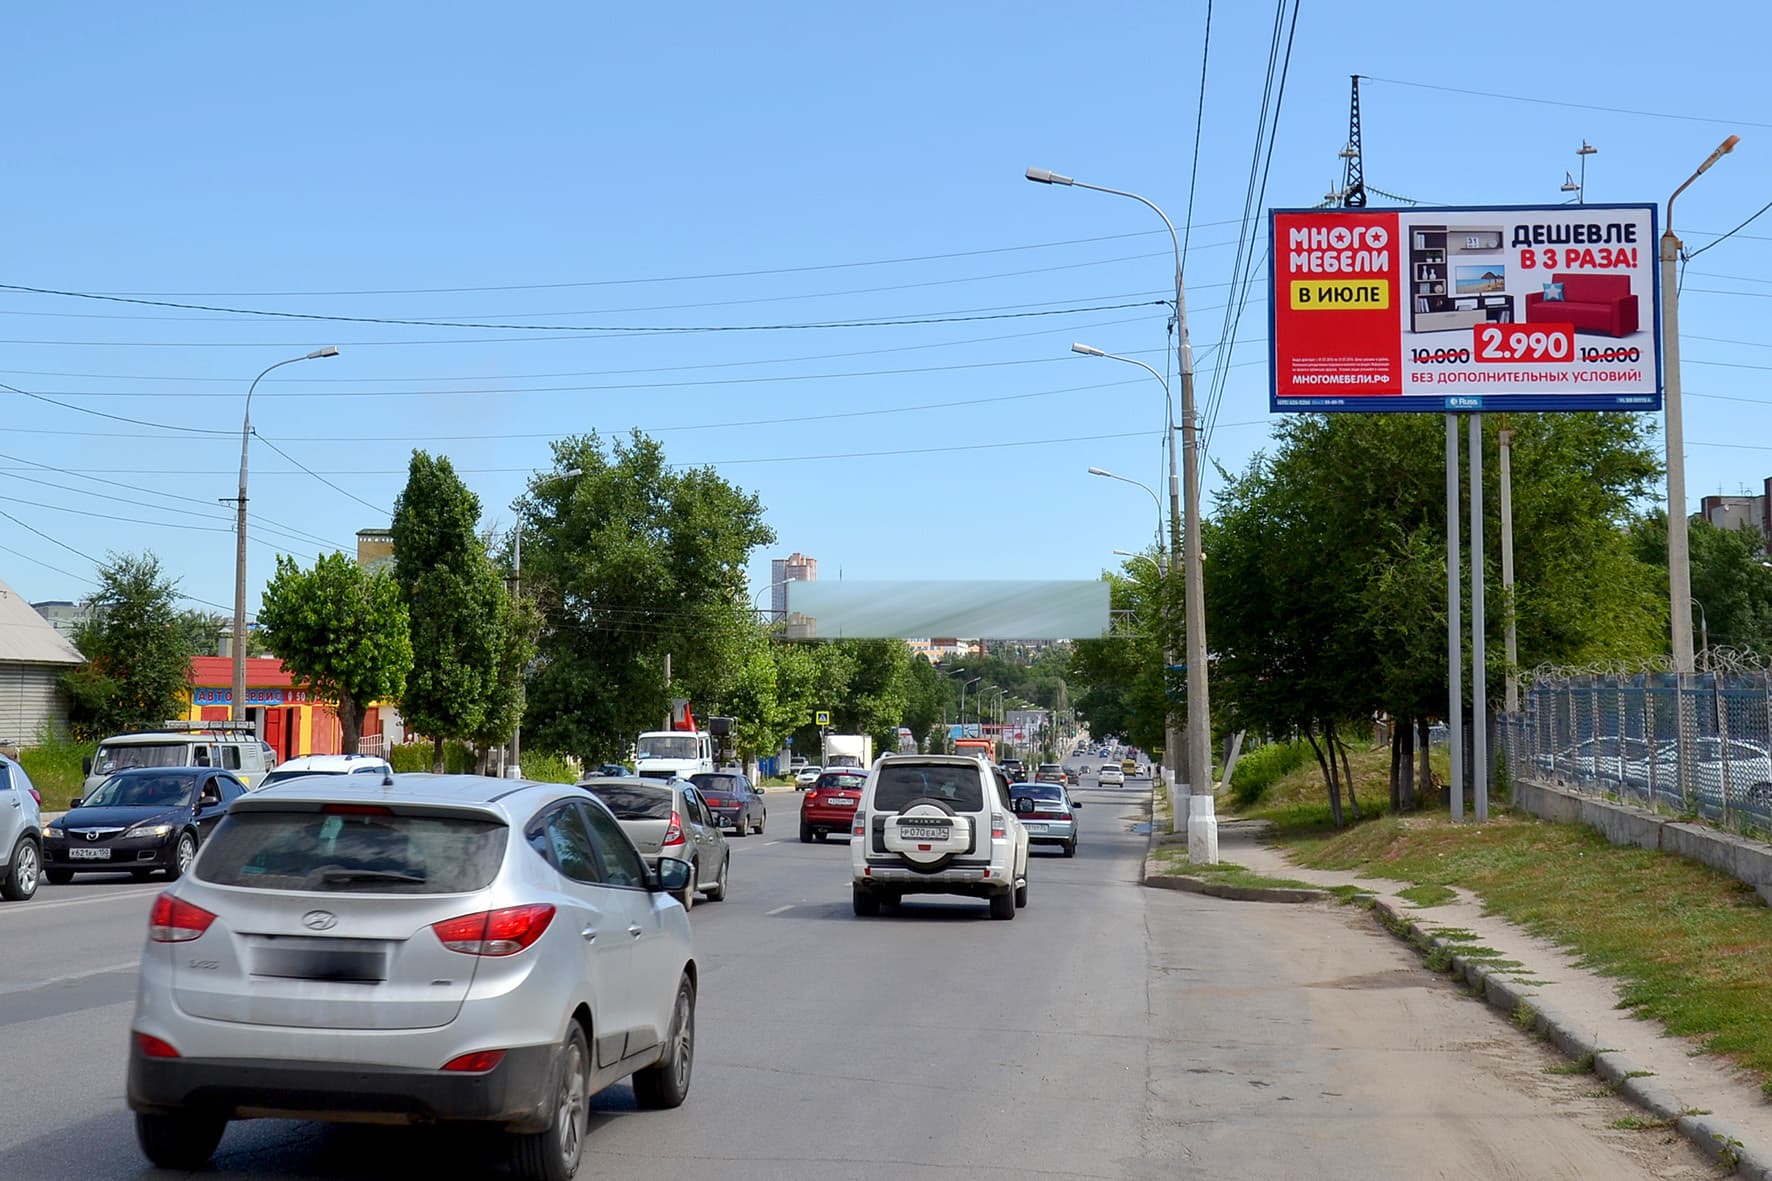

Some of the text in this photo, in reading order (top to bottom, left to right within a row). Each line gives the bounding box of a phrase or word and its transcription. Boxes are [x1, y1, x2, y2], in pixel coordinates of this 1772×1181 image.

[1289, 226, 1389, 249] МНОГО
[1512, 223, 1636, 248] ДЕШЕВЛЕ
[1289, 250, 1389, 273] МЕБЕЛИ
[1520, 247, 1639, 269] В 3 РАЗА!
[1298, 287, 1380, 303] В ИЮЛЕ
[1411, 327, 1641, 364] 10.000 2.990 10.000
[1292, 374, 1390, 384] МНОГОМЕБЕЛИ.РФ
[1411, 369, 1642, 384] БЕЗ ДОПОЛНИТЕЛЬНЫХ УСЛОВИЙ!
[198, 690, 281, 702] АВТОЕРВИС
